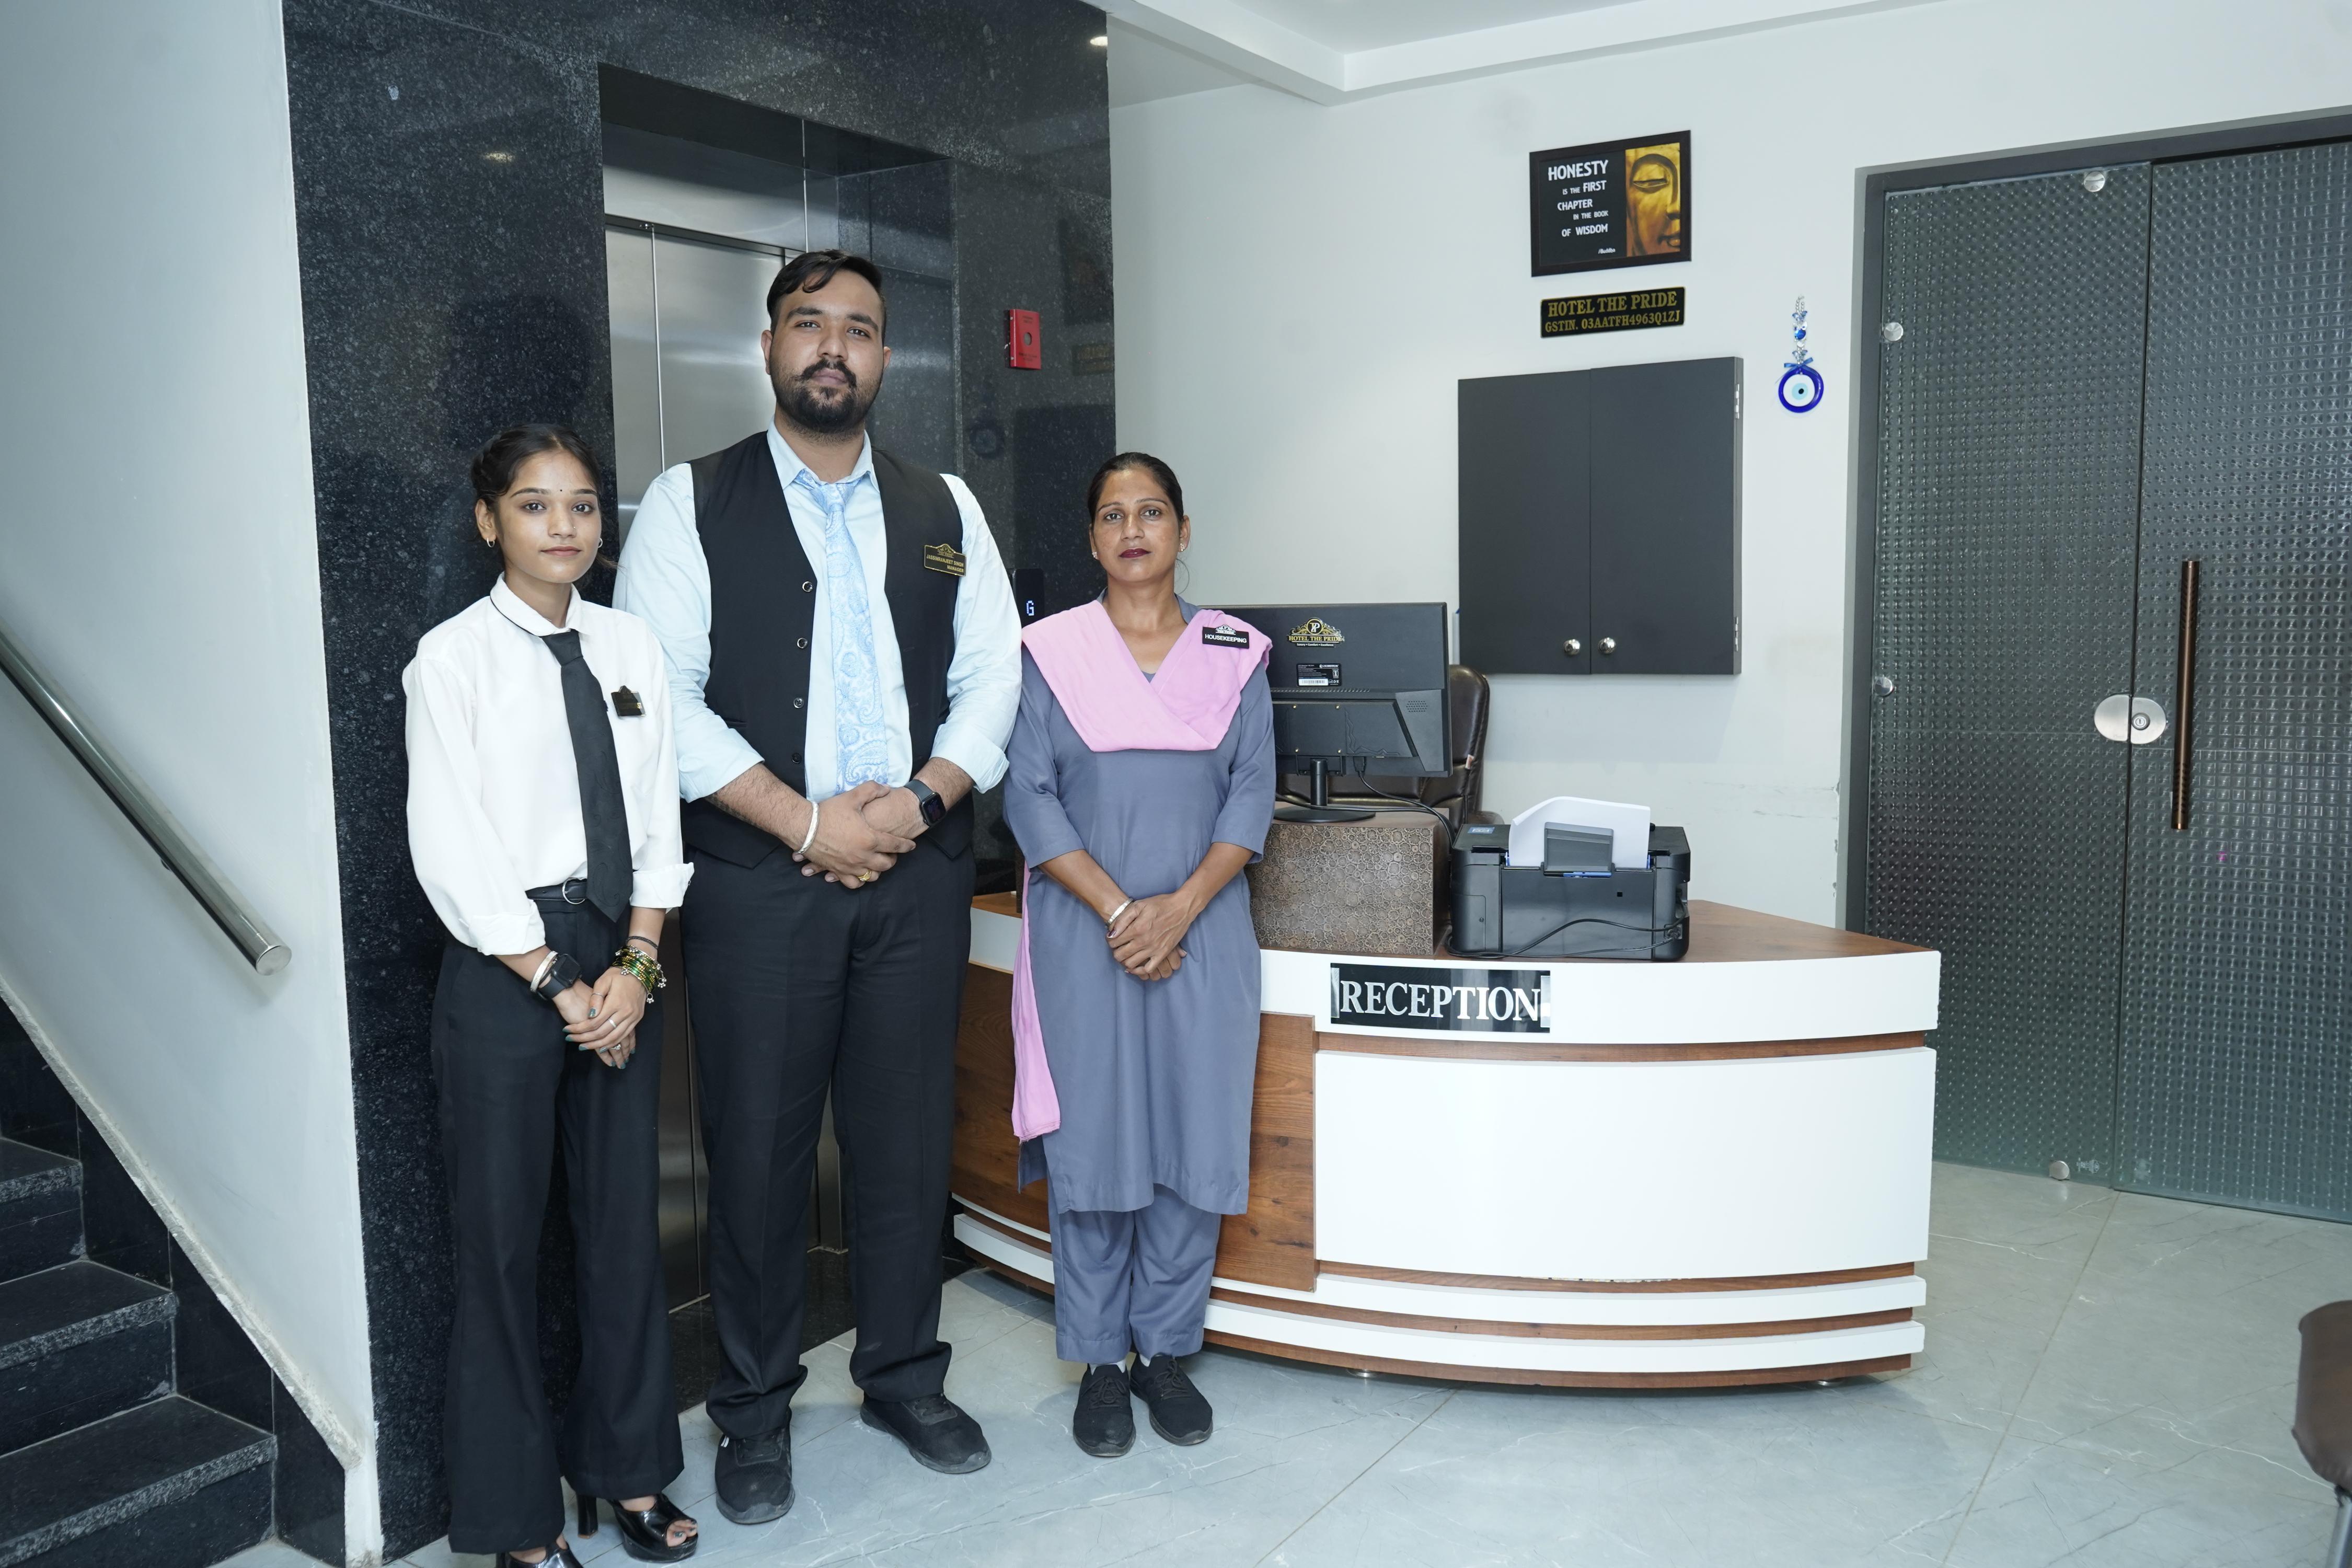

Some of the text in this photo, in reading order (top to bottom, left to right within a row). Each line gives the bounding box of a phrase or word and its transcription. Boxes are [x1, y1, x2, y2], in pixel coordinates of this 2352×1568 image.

[1548, 159, 1608, 181] HONESTY
[1583, 180, 1607, 192] FIRST
[1558, 199, 1593, 211] CHAPTER
[1562, 223, 1608, 237] OF WISDOM
[1548, 291, 1677, 318] HOTEL THE PRIDE
[1545, 319, 1578, 333] GSTIN.
[1026, 600, 1034, 616] G
[1205, 633, 1247, 643] HOUSEKEEPING
[1340, 980, 1541, 1022] RECEPTION
